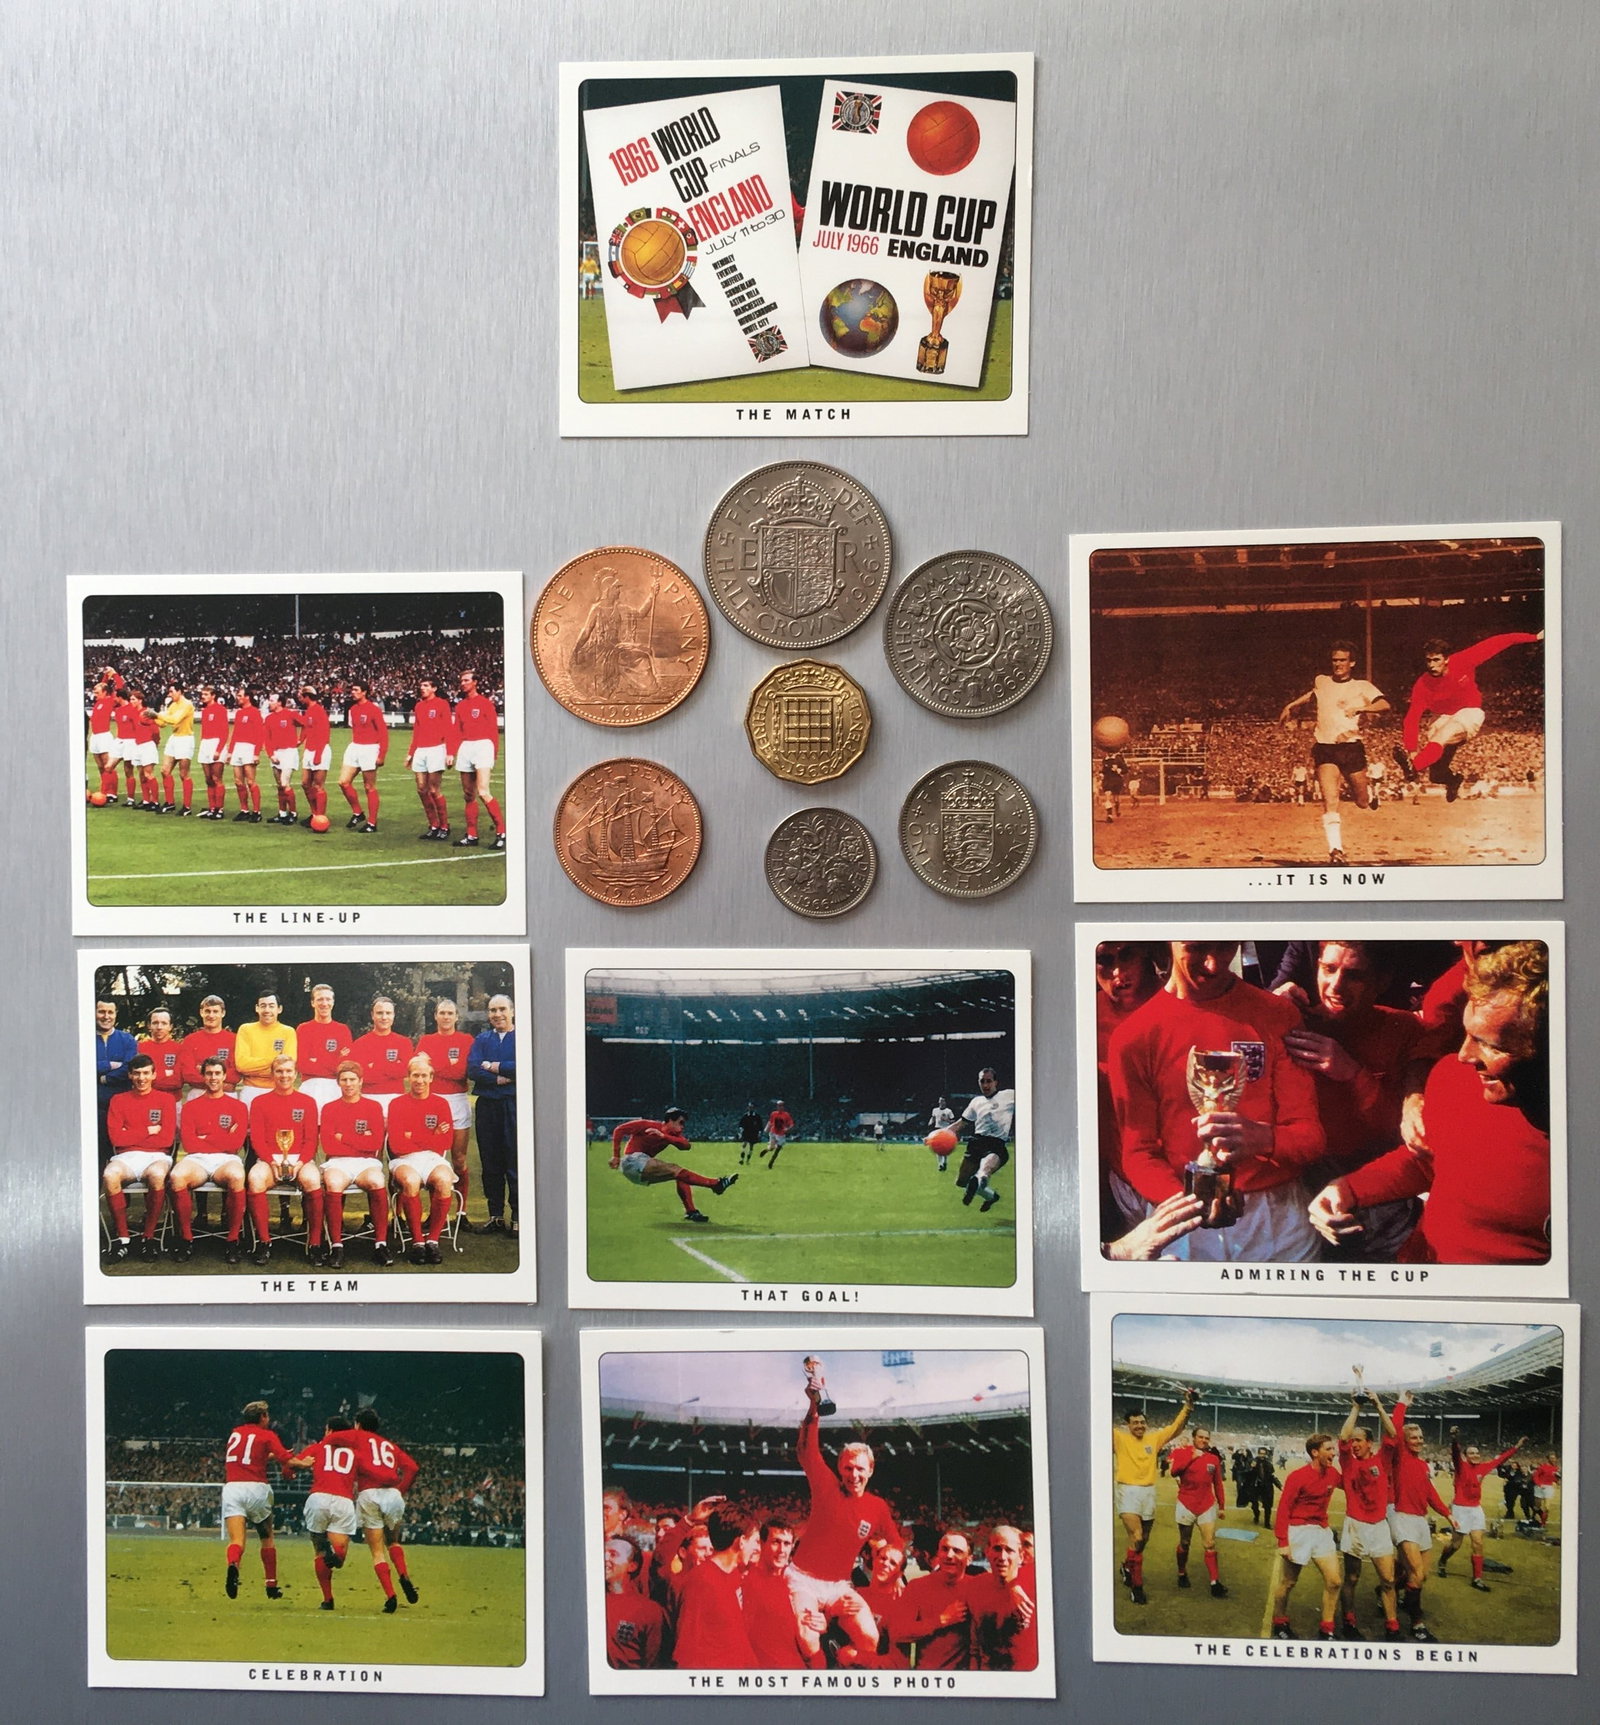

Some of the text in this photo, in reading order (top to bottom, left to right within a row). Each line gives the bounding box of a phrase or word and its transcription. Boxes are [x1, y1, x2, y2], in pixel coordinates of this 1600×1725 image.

[608, 106, 721, 186] 1966 WORLD
[669, 142, 761, 204] CUP FINALS
[686, 174, 773, 242] ENGLAND
[819, 180, 998, 245] WORLD CUP
[705, 210, 786, 256] JULY 11 to 30
[812, 230, 989, 268] JULY 1966 ENGLAND
[736, 408, 850, 420] THE MATCH
[739, 537, 860, 574] E R
[716, 556, 755, 615] HALF
[756, 607, 847, 638] CROWN
[544, 581, 700, 672] ONE PENNY
[896, 619, 962, 706] SHILLINGS
[599, 704, 645, 718] 1966
[628, 764, 688, 806] PENNY
[602, 884, 652, 900] 1966
[1309, 873, 1328, 886] IS
[1343, 873, 1385, 886] NOW
[233, 912, 360, 923] THE LINE-UP
[260, 1280, 358, 1292] THE TEAM
[1220, 1268, 1429, 1282] ADMIRING THE CUP
[741, 1289, 858, 1302] THAT GOAL!
[226, 1432, 256, 1465] 21
[324, 1438, 396, 1474] 10 16
[1194, 1643, 1478, 1662] THE CELEBRATIONS BEGIN
[249, 1668, 382, 1682] CELEBRATION
[689, 1676, 955, 1689] THE MOST FAMOUS PHOTO
